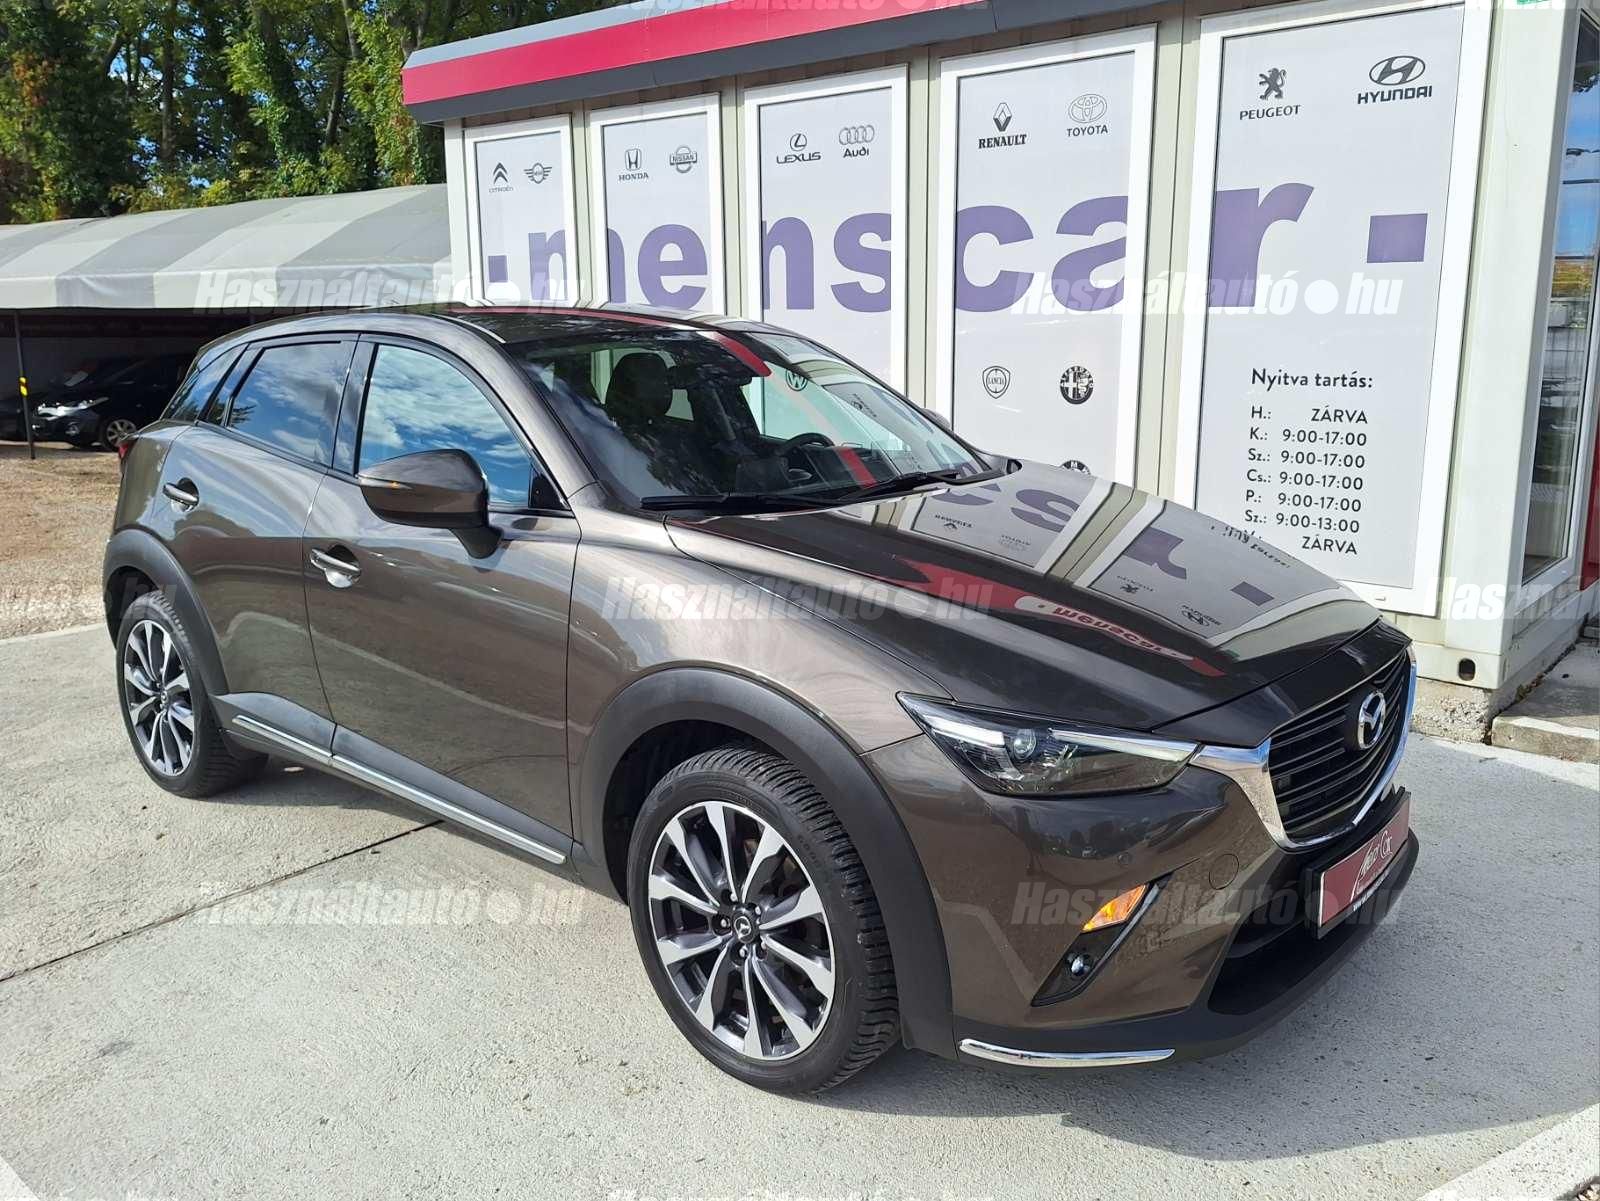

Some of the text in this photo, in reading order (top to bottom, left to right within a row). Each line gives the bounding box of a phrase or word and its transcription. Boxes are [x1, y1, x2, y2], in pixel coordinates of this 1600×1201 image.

[1357, 85, 1433, 105] HYUNDAI
[1239, 105, 1300, 120] PEUGEOT
[1067, 125, 1108, 137] TOYOTA
[978, 134, 1027, 149] RENAULT
[776, 152, 821, 164] LEXUS
[843, 146, 870, 158] Audi
[618, 172, 649, 182] HONDA
[1252, 368, 1373, 392] Nyitva tartás:
[1251, 405, 1368, 424] H.: ZÁRVA
[1250, 427, 1367, 446] K.: 9:00-17:00
[1248, 448, 1365, 468] Sz.: 9:00-17:00
[1247, 469, 1363, 490] Cs.: 9:00-17:00
[1246, 489, 1361, 512] P.: 9:00-17:00
[1245, 509, 1360, 533] Sz.: 9:00-13:00
[1302, 534, 1357, 555] ZÁRVA
